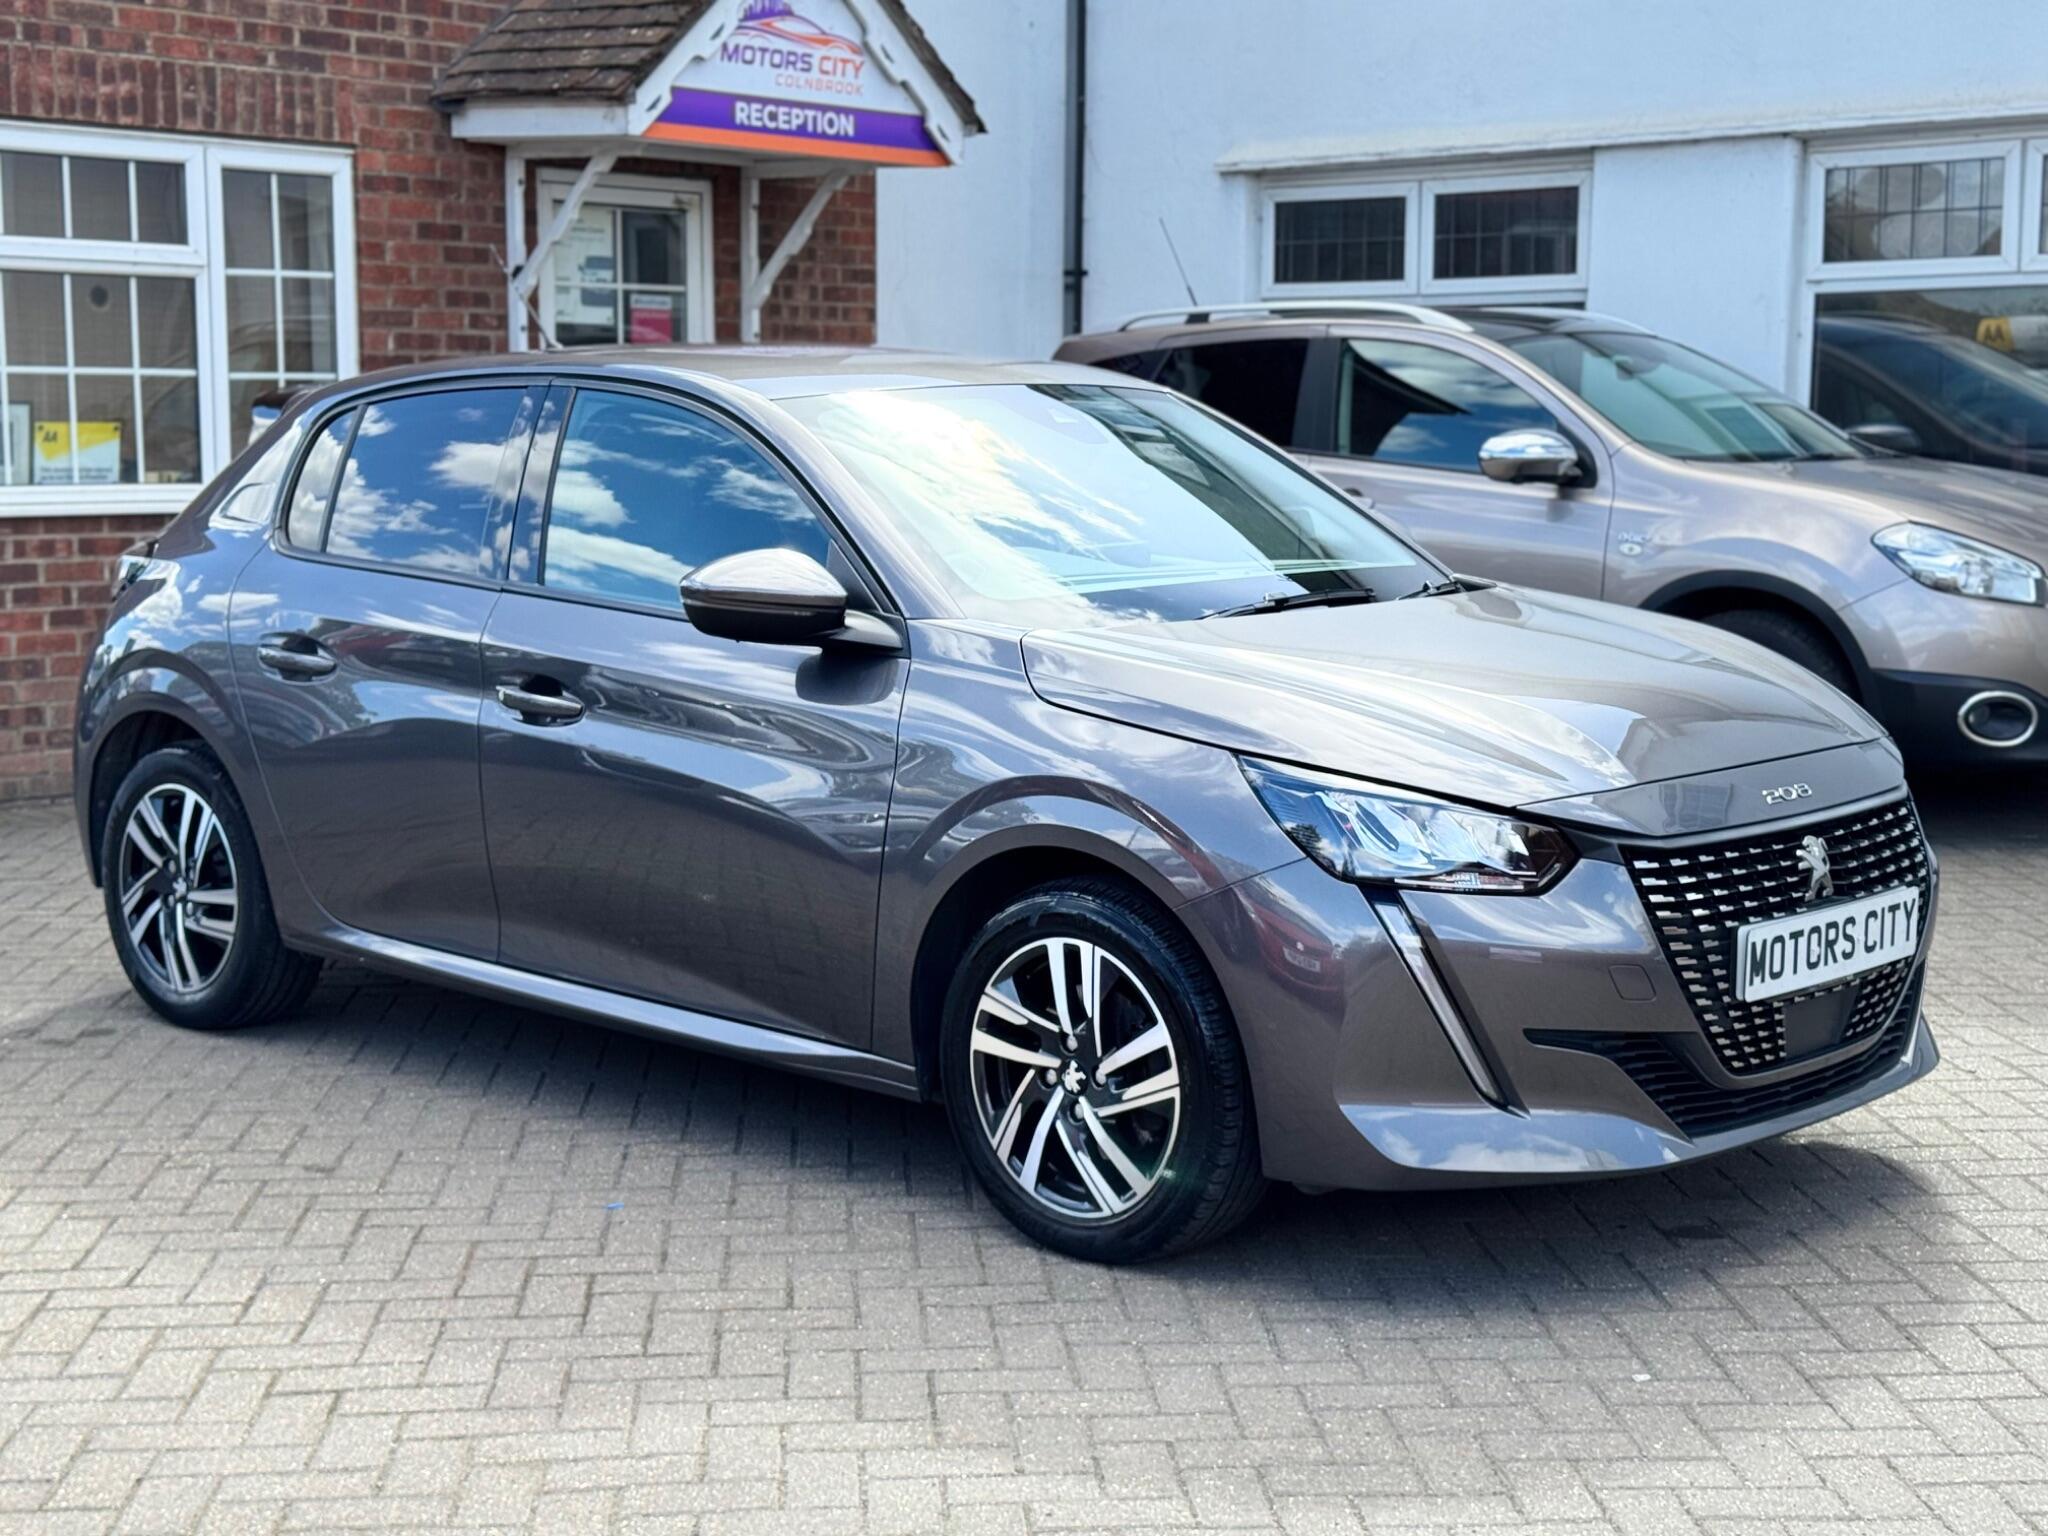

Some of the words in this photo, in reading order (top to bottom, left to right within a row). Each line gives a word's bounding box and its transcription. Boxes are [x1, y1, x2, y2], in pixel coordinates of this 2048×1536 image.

[720, 42, 812, 72] MOTORS
[818, 55, 865, 79] CITY
[775, 73, 864, 96] COLNBROOK
[734, 101, 855, 137] RECEPTION
[1762, 782, 1813, 805] 208
[1748, 915, 1856, 987] MOTORS
[1864, 897, 1917, 955] CITY
